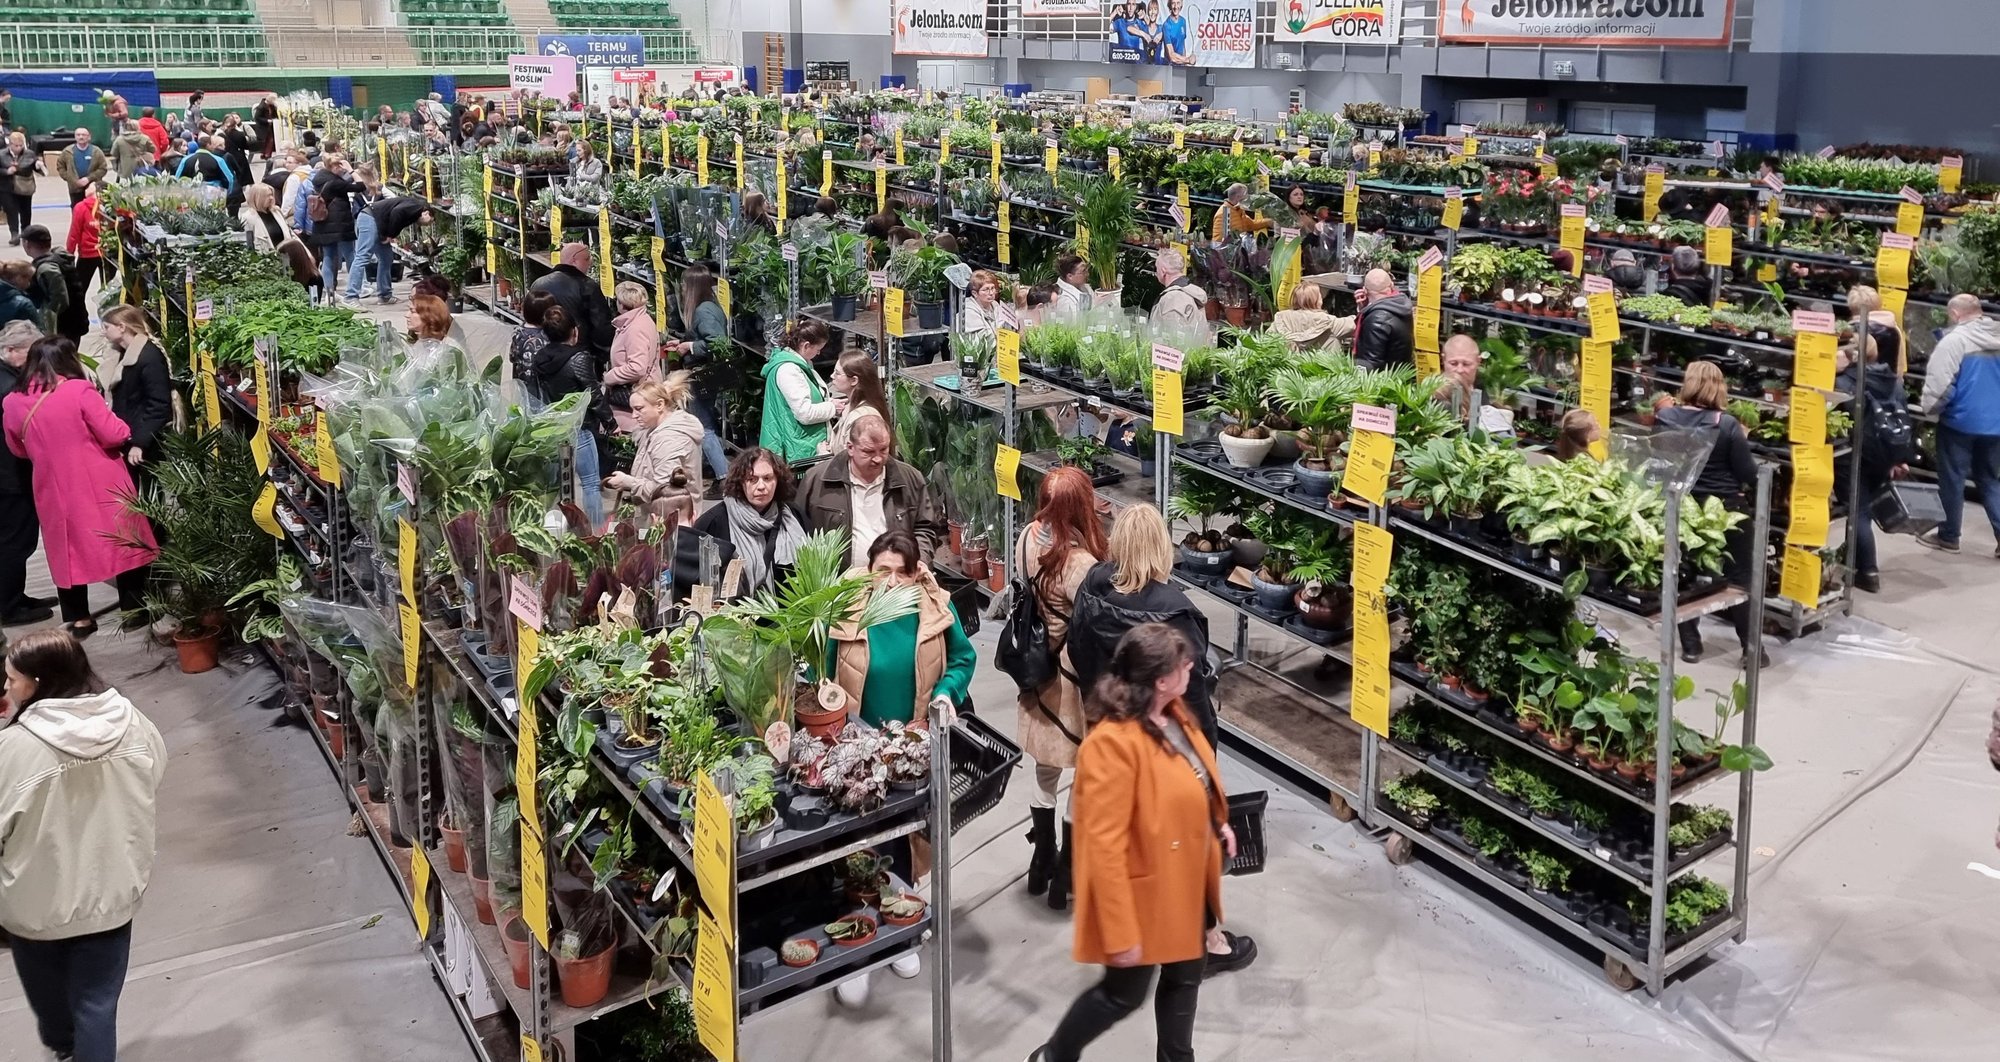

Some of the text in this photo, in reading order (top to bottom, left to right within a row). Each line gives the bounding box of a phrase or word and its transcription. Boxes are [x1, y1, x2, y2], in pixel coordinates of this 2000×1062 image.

[910, 9, 983, 29] Jelonka.com
[1207, 8, 1252, 23] STREFA
[1331, 11, 1382, 37] GÓRA
[1519, 22, 1656, 36] Twoje źródło informacji
[1197, 23, 1251, 39] SQUASH
[587, 42, 627, 52] TERMY
[1201, 40, 1251, 51] & FITNESS
[576, 54, 638, 65] CIEPLICKIE
[513, 65, 552, 74] FESTIWAL
[514, 71, 543, 83] ROŚLIN
